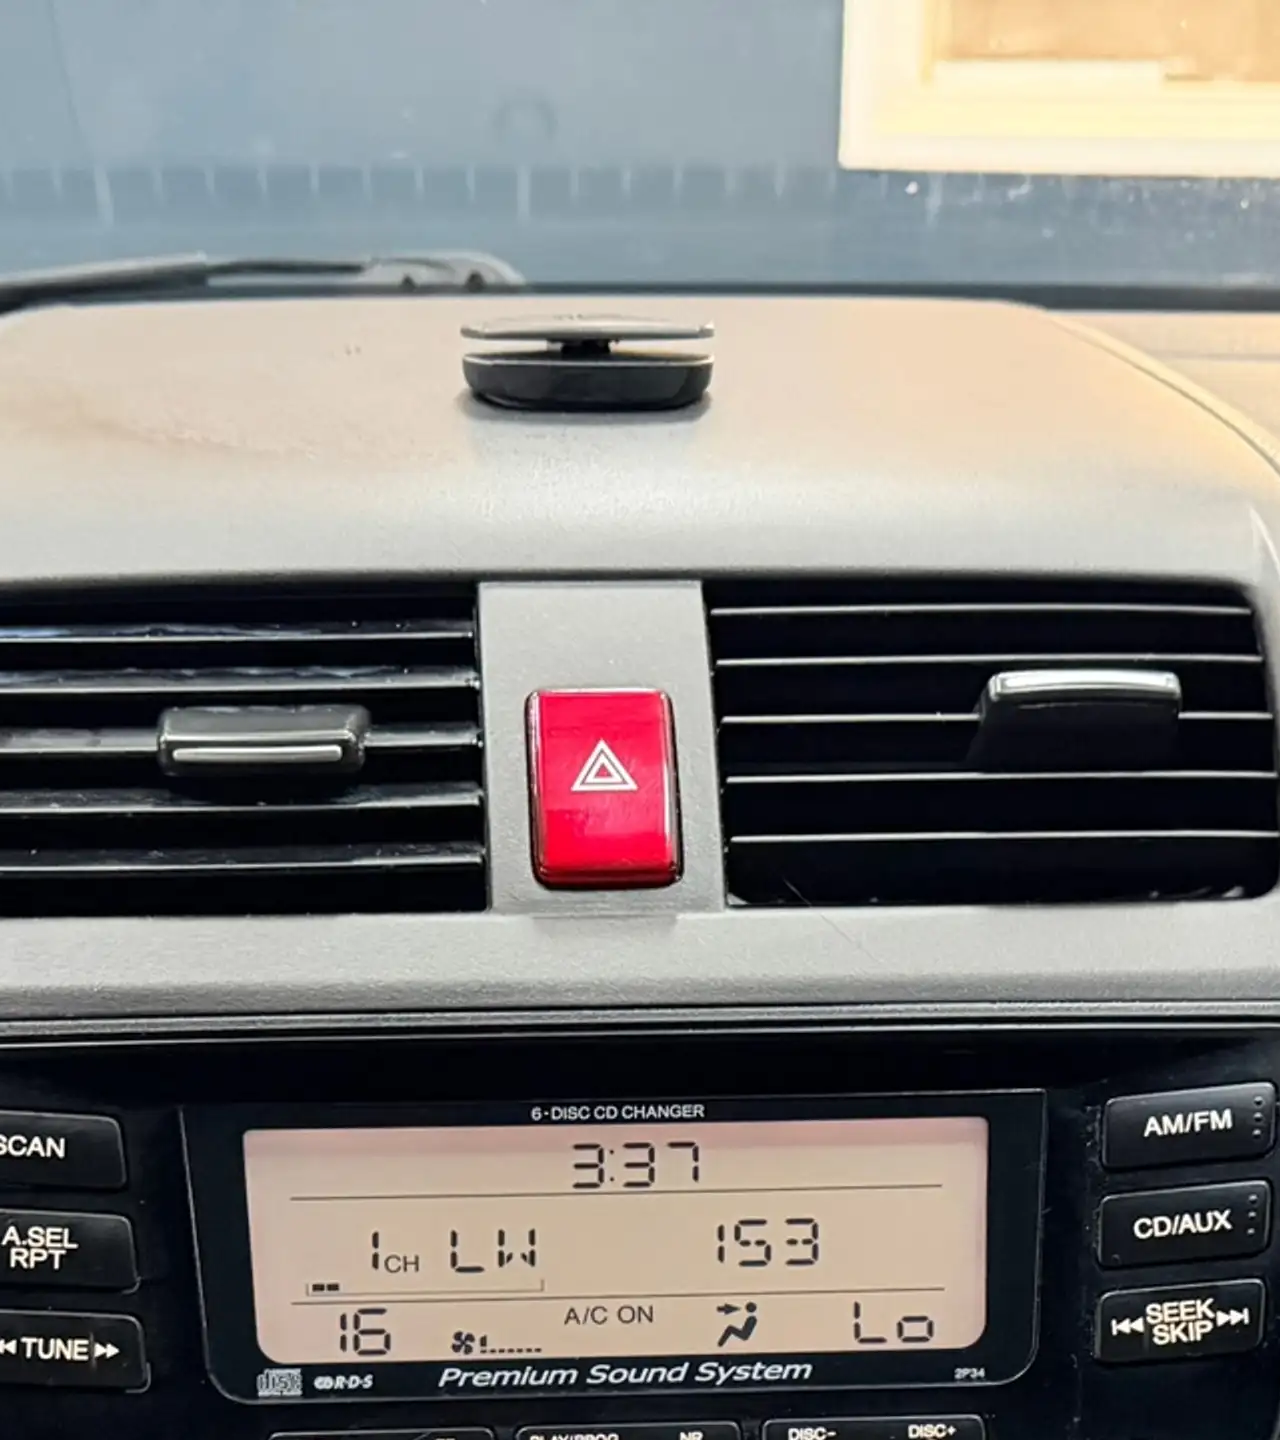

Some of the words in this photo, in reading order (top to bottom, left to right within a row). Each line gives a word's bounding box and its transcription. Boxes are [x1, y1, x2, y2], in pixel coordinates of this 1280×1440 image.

[594, 1106, 618, 1119] CD
[622, 1104, 705, 1119] CHANGER
[1142, 1109, 1233, 1137] AM/FM
[572, 1141, 699, 1189] 3:37
[1134, 1210, 1231, 1238] CD/AUX
[2, 1226, 78, 1249] A.SEL
[451, 1229, 535, 1273] LW
[718, 1218, 818, 1267] 153
[10, 1248, 66, 1269] RPT
[564, 1306, 607, 1325] A/C
[618, 1306, 653, 1324] ON
[854, 1302, 933, 1344] Lo
[1145, 1300, 1214, 1325] SEEK
[340, 1308, 390, 1356] 16
[1152, 1321, 1213, 1345] SKIP
[21, 1337, 89, 1360] TUNE
[439, 1366, 578, 1387] Premium
[587, 1362, 689, 1383] Sound
[695, 1362, 812, 1385] System
[955, 1368, 984, 1379] 2P34
[908, 1424, 955, 1439] DISC+
